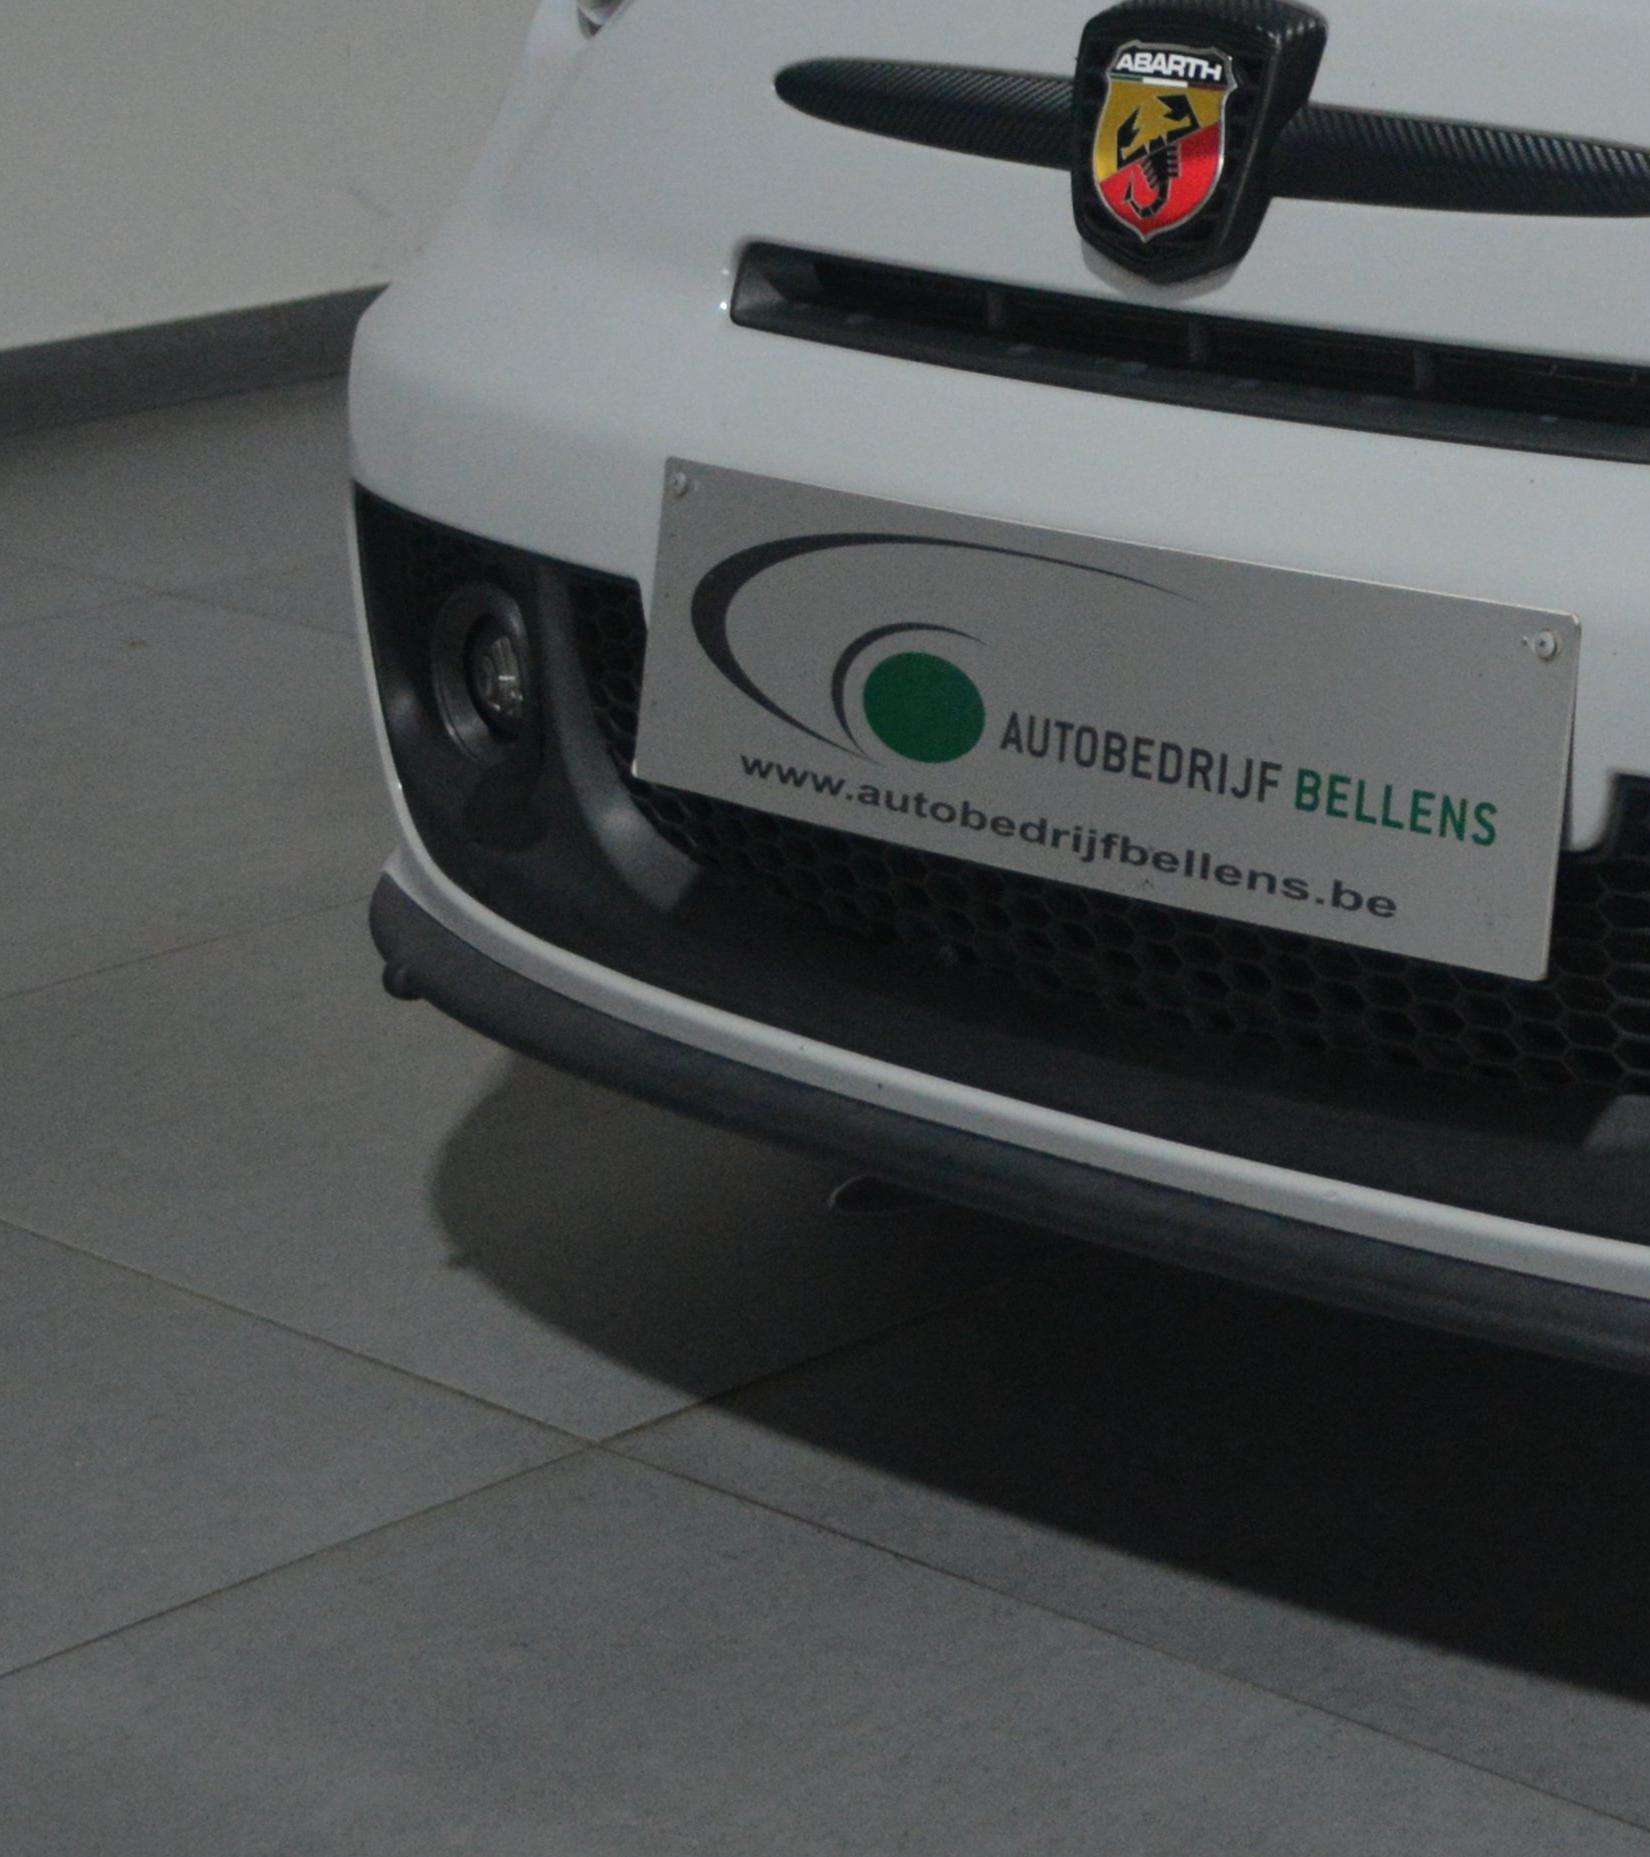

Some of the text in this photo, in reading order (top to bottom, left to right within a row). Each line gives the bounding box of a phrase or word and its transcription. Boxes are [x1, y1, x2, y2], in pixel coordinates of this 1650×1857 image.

[1115, 52, 1223, 82] ABARTH
[739, 751, 1398, 919] www.autobedrijfbellens.be
[1000, 711, 1499, 847] AUTOBEDRIJF BELLENS
